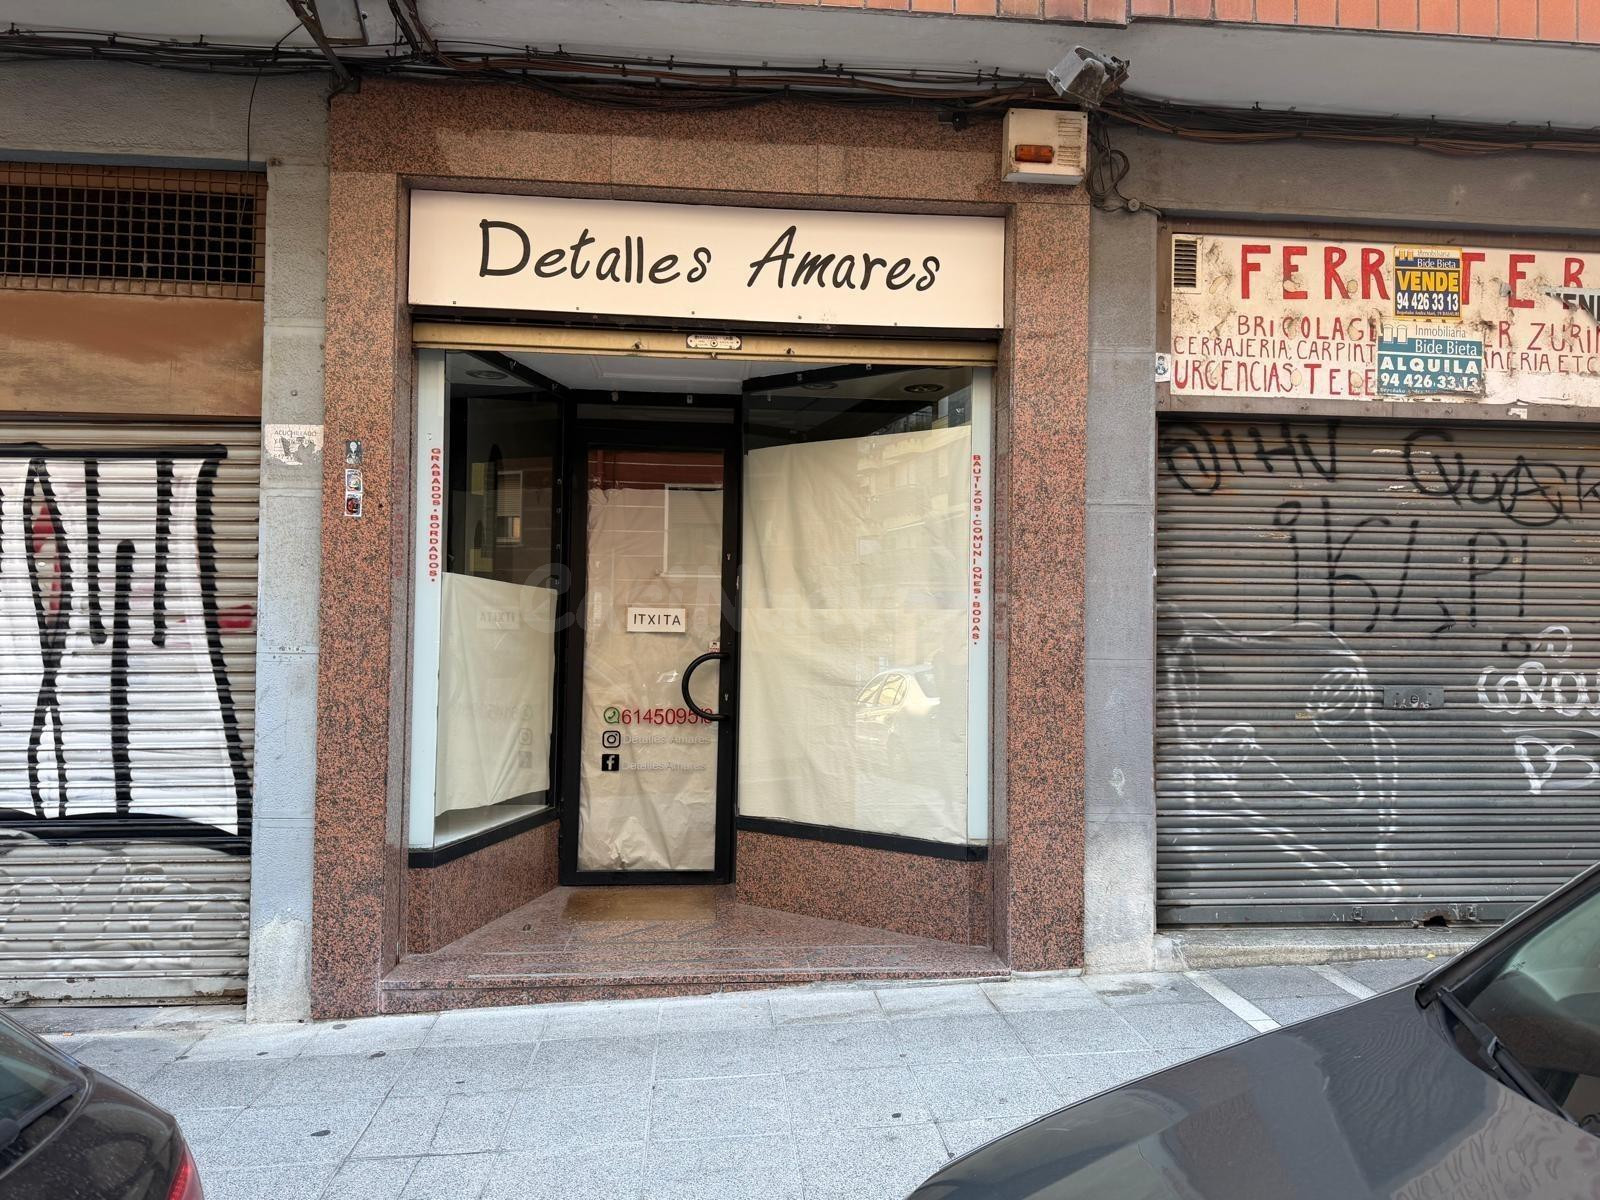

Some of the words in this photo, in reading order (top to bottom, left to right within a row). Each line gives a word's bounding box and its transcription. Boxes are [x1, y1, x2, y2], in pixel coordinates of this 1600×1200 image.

[478, 218, 712, 285] Detalles
[746, 225, 941, 292] Amares
[1417, 258, 1435, 268] Bide
[1437, 259, 1456, 269] Bieta
[1396, 270, 1459, 292] VENDE
[1397, 292, 1409, 310] 94
[1411, 293, 1429, 310] 426
[1432, 294, 1444, 310] 33
[1447, 294, 1459, 311] 13
[1415, 325, 1466, 338] Inmobiliaria
[1415, 340, 1443, 354] Bide
[1447, 341, 1477, 355] Bieta
[1380, 356, 1479, 375] ALQUILA
[1380, 373, 1400, 387] 94
[430, 448, 442, 506] GRABADOS
[972, 454, 983, 512] BAUTIZOS
[428, 514, 440, 577] BORDADOS
[972, 519, 983, 594] COMUNIONES
[633, 613, 681, 626] ITXITA
[971, 601, 981, 640] BODAS
